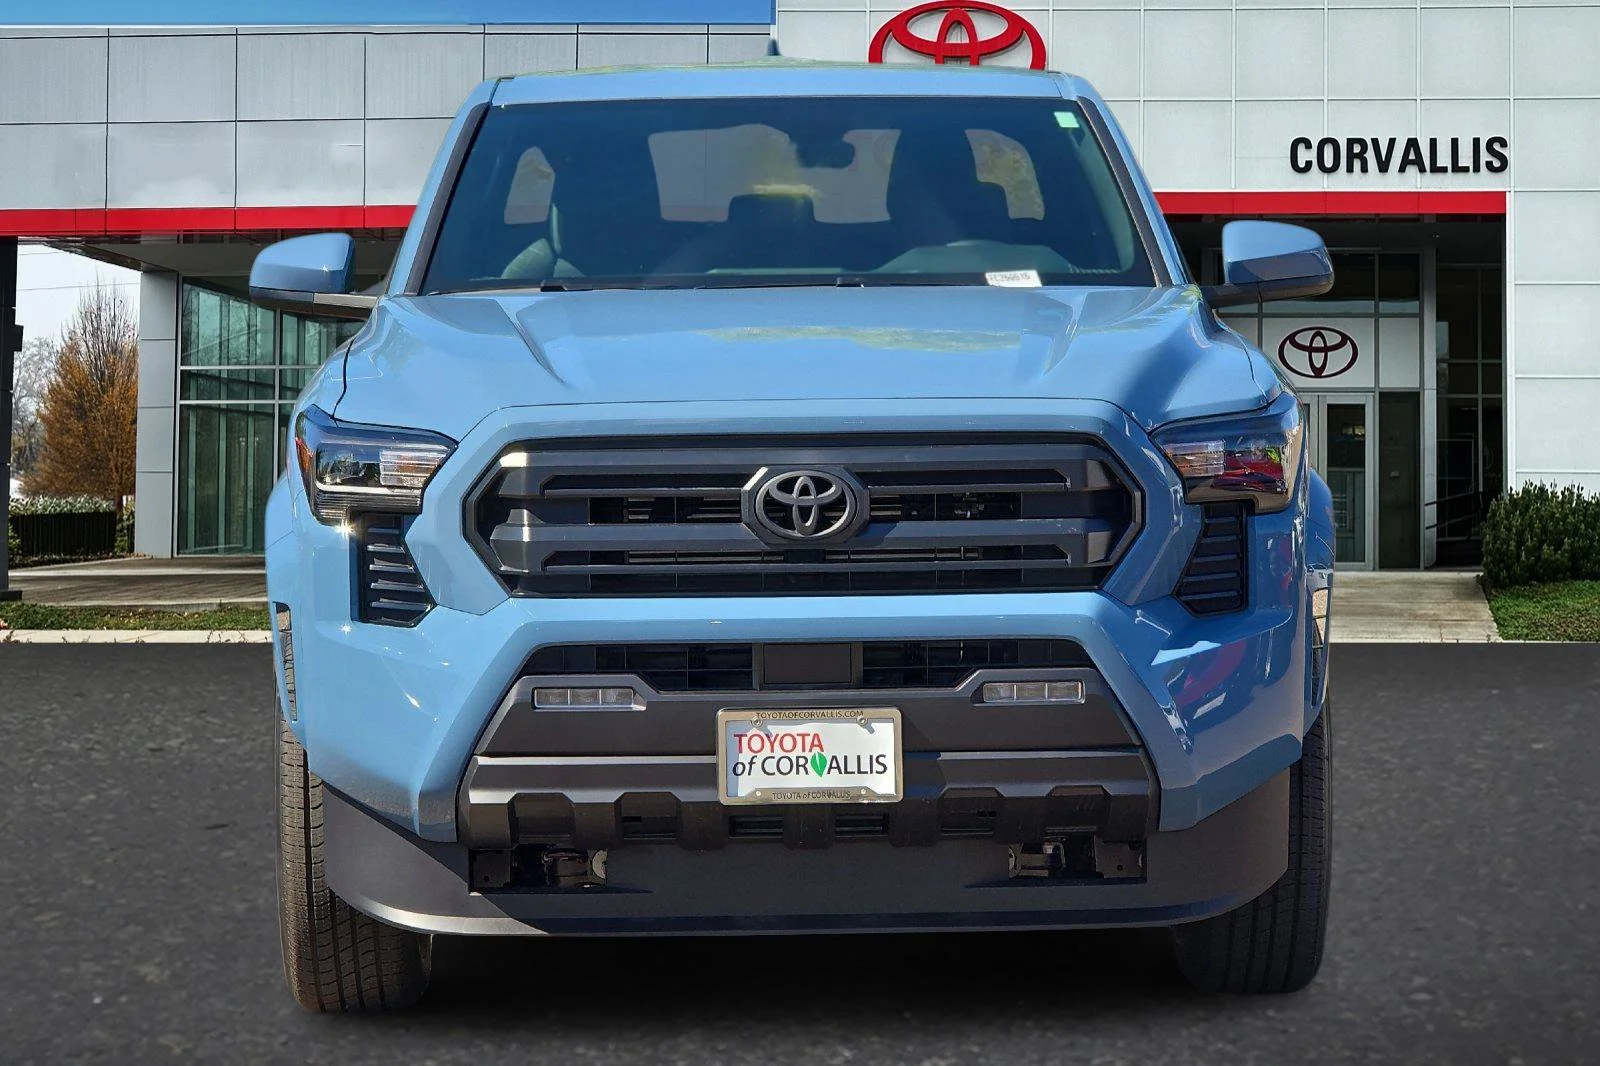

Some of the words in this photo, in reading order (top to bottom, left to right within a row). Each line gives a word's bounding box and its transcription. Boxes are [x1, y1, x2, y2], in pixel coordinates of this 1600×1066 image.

[1290, 136, 1509, 173] CORVALLIS
[756, 710, 864, 719] TOYOTAOFCORVALLIS.COM
[733, 733, 825, 754] TOYOTA
[732, 755, 757, 776] of
[772, 792, 801, 800] TOYOTA
